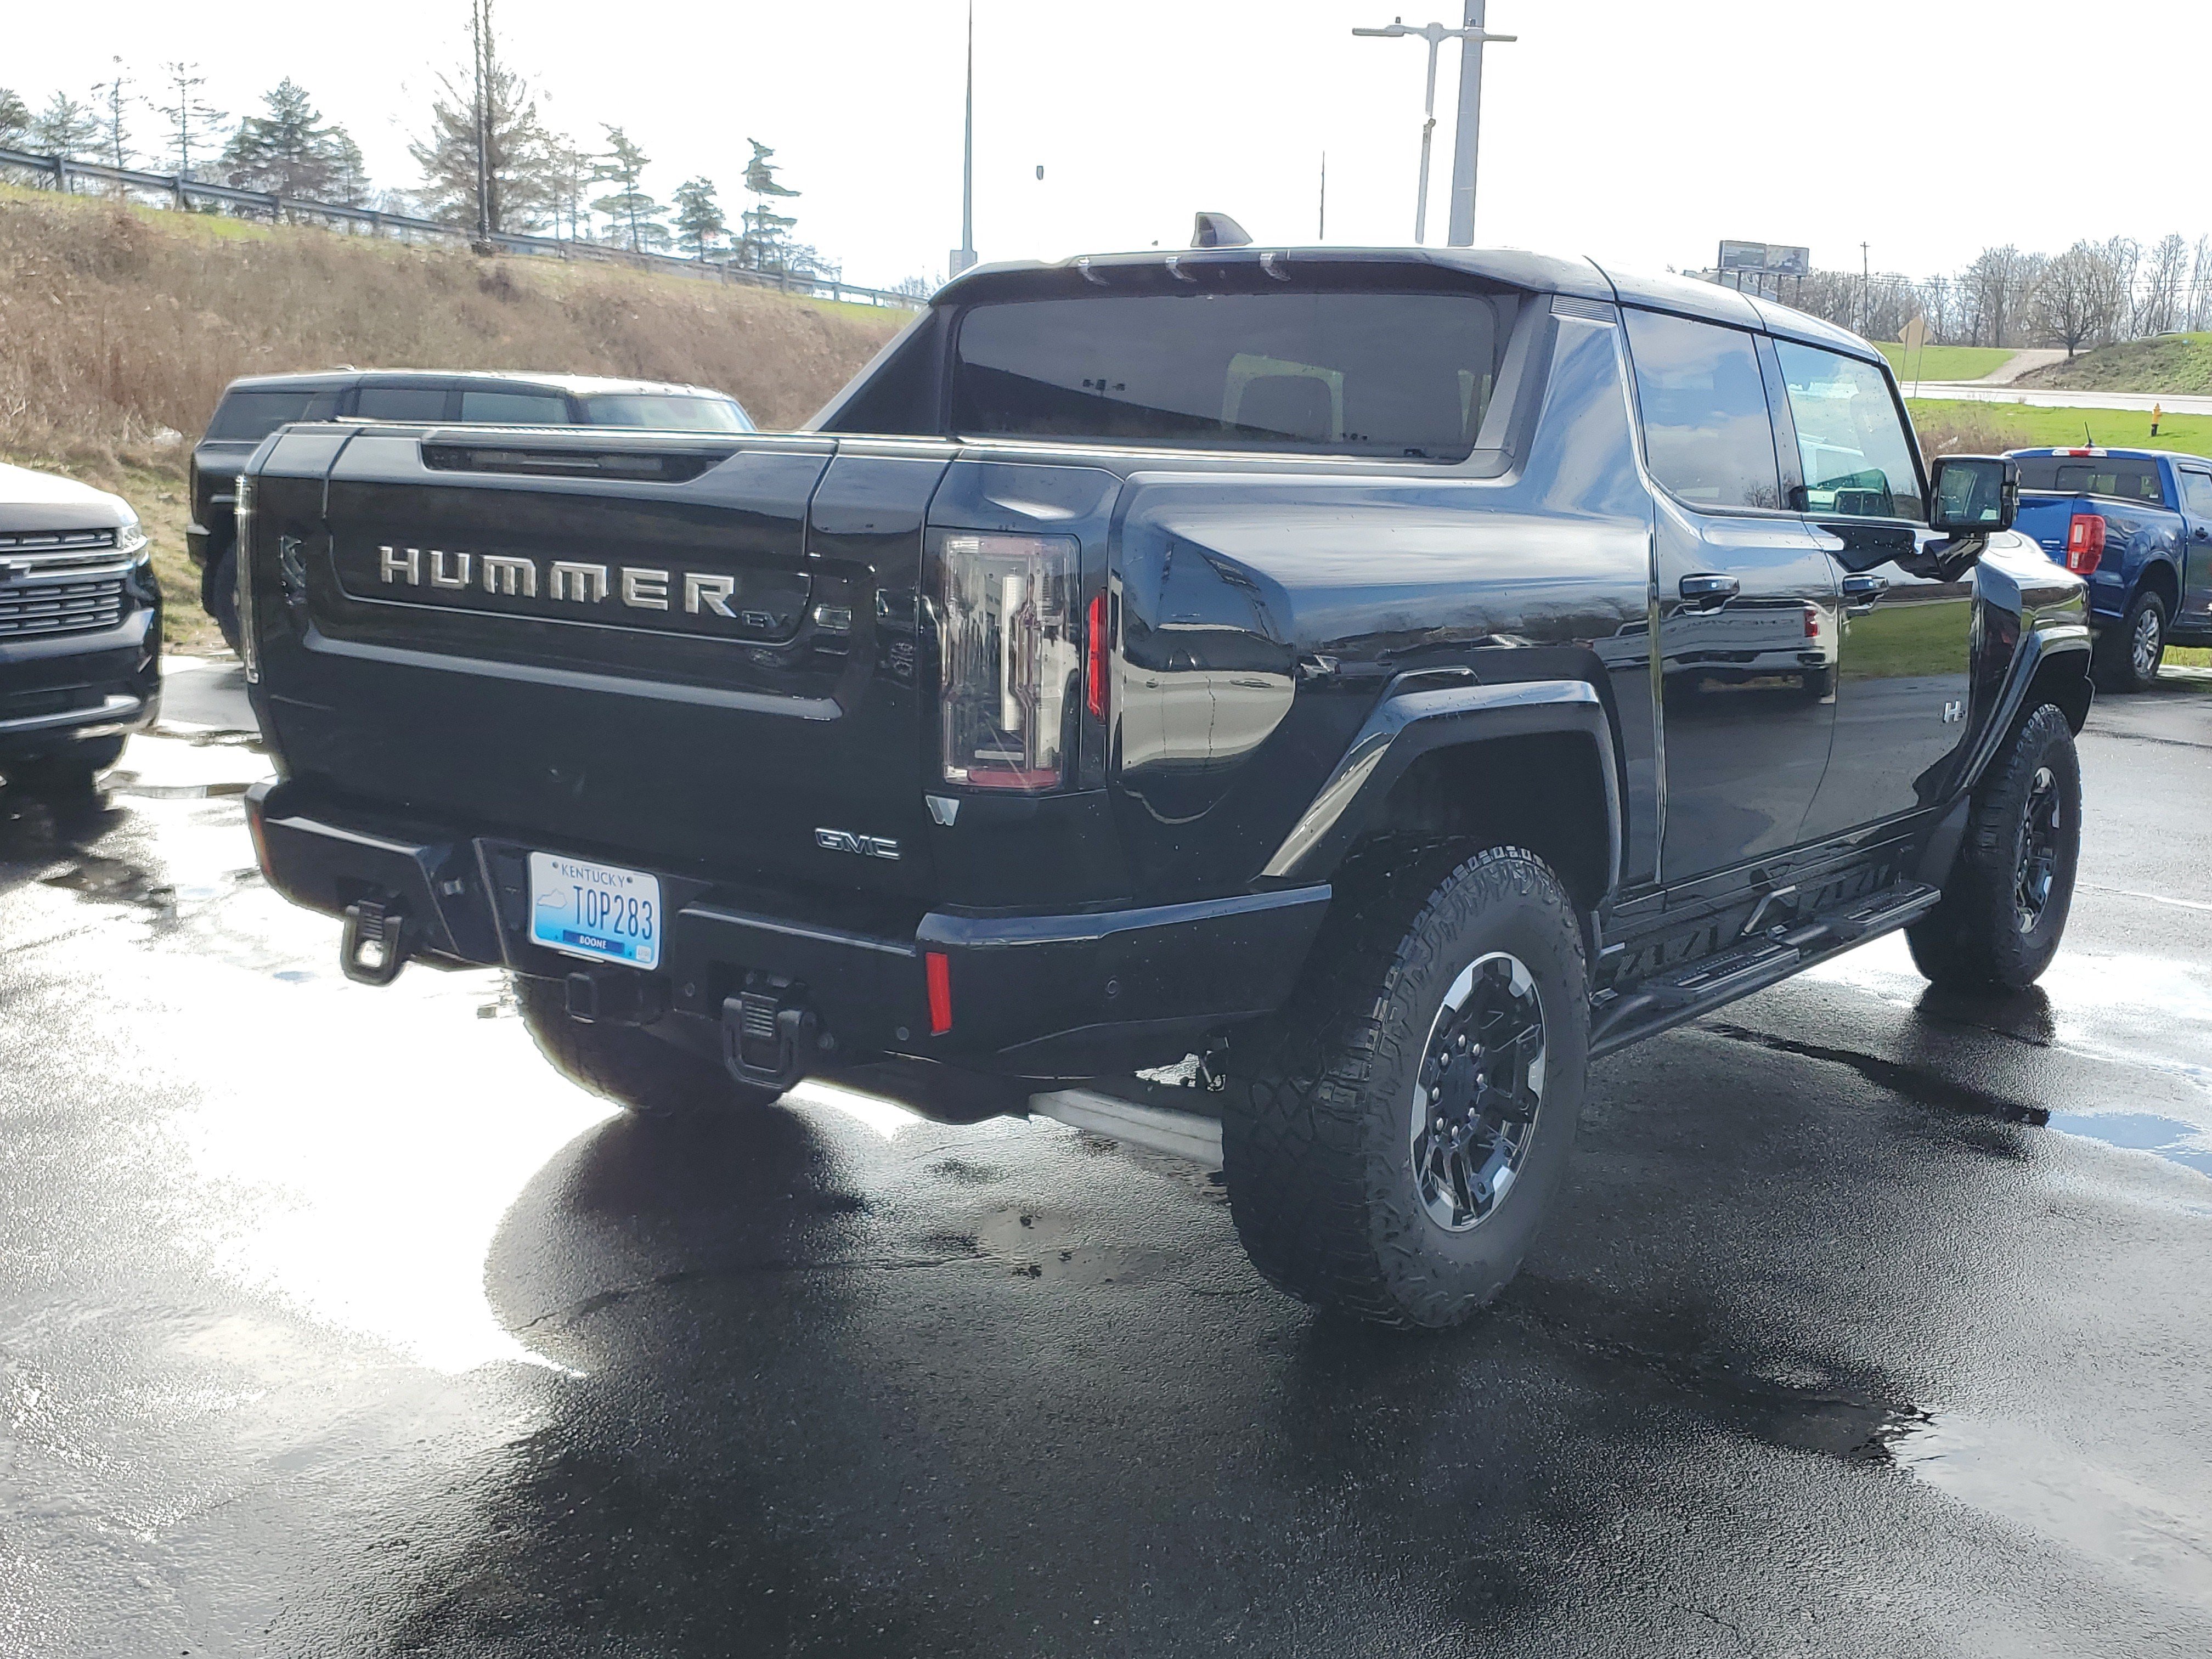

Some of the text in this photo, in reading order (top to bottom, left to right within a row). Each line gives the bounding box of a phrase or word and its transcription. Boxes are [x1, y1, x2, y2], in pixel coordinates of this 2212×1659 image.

[379, 545, 736, 618] HUMMER
[815, 827, 901, 860] GMC
[562, 864, 625, 888] KENTUCKY
[573, 885, 653, 940] TOP283
[579, 935, 607, 949] BOONE
